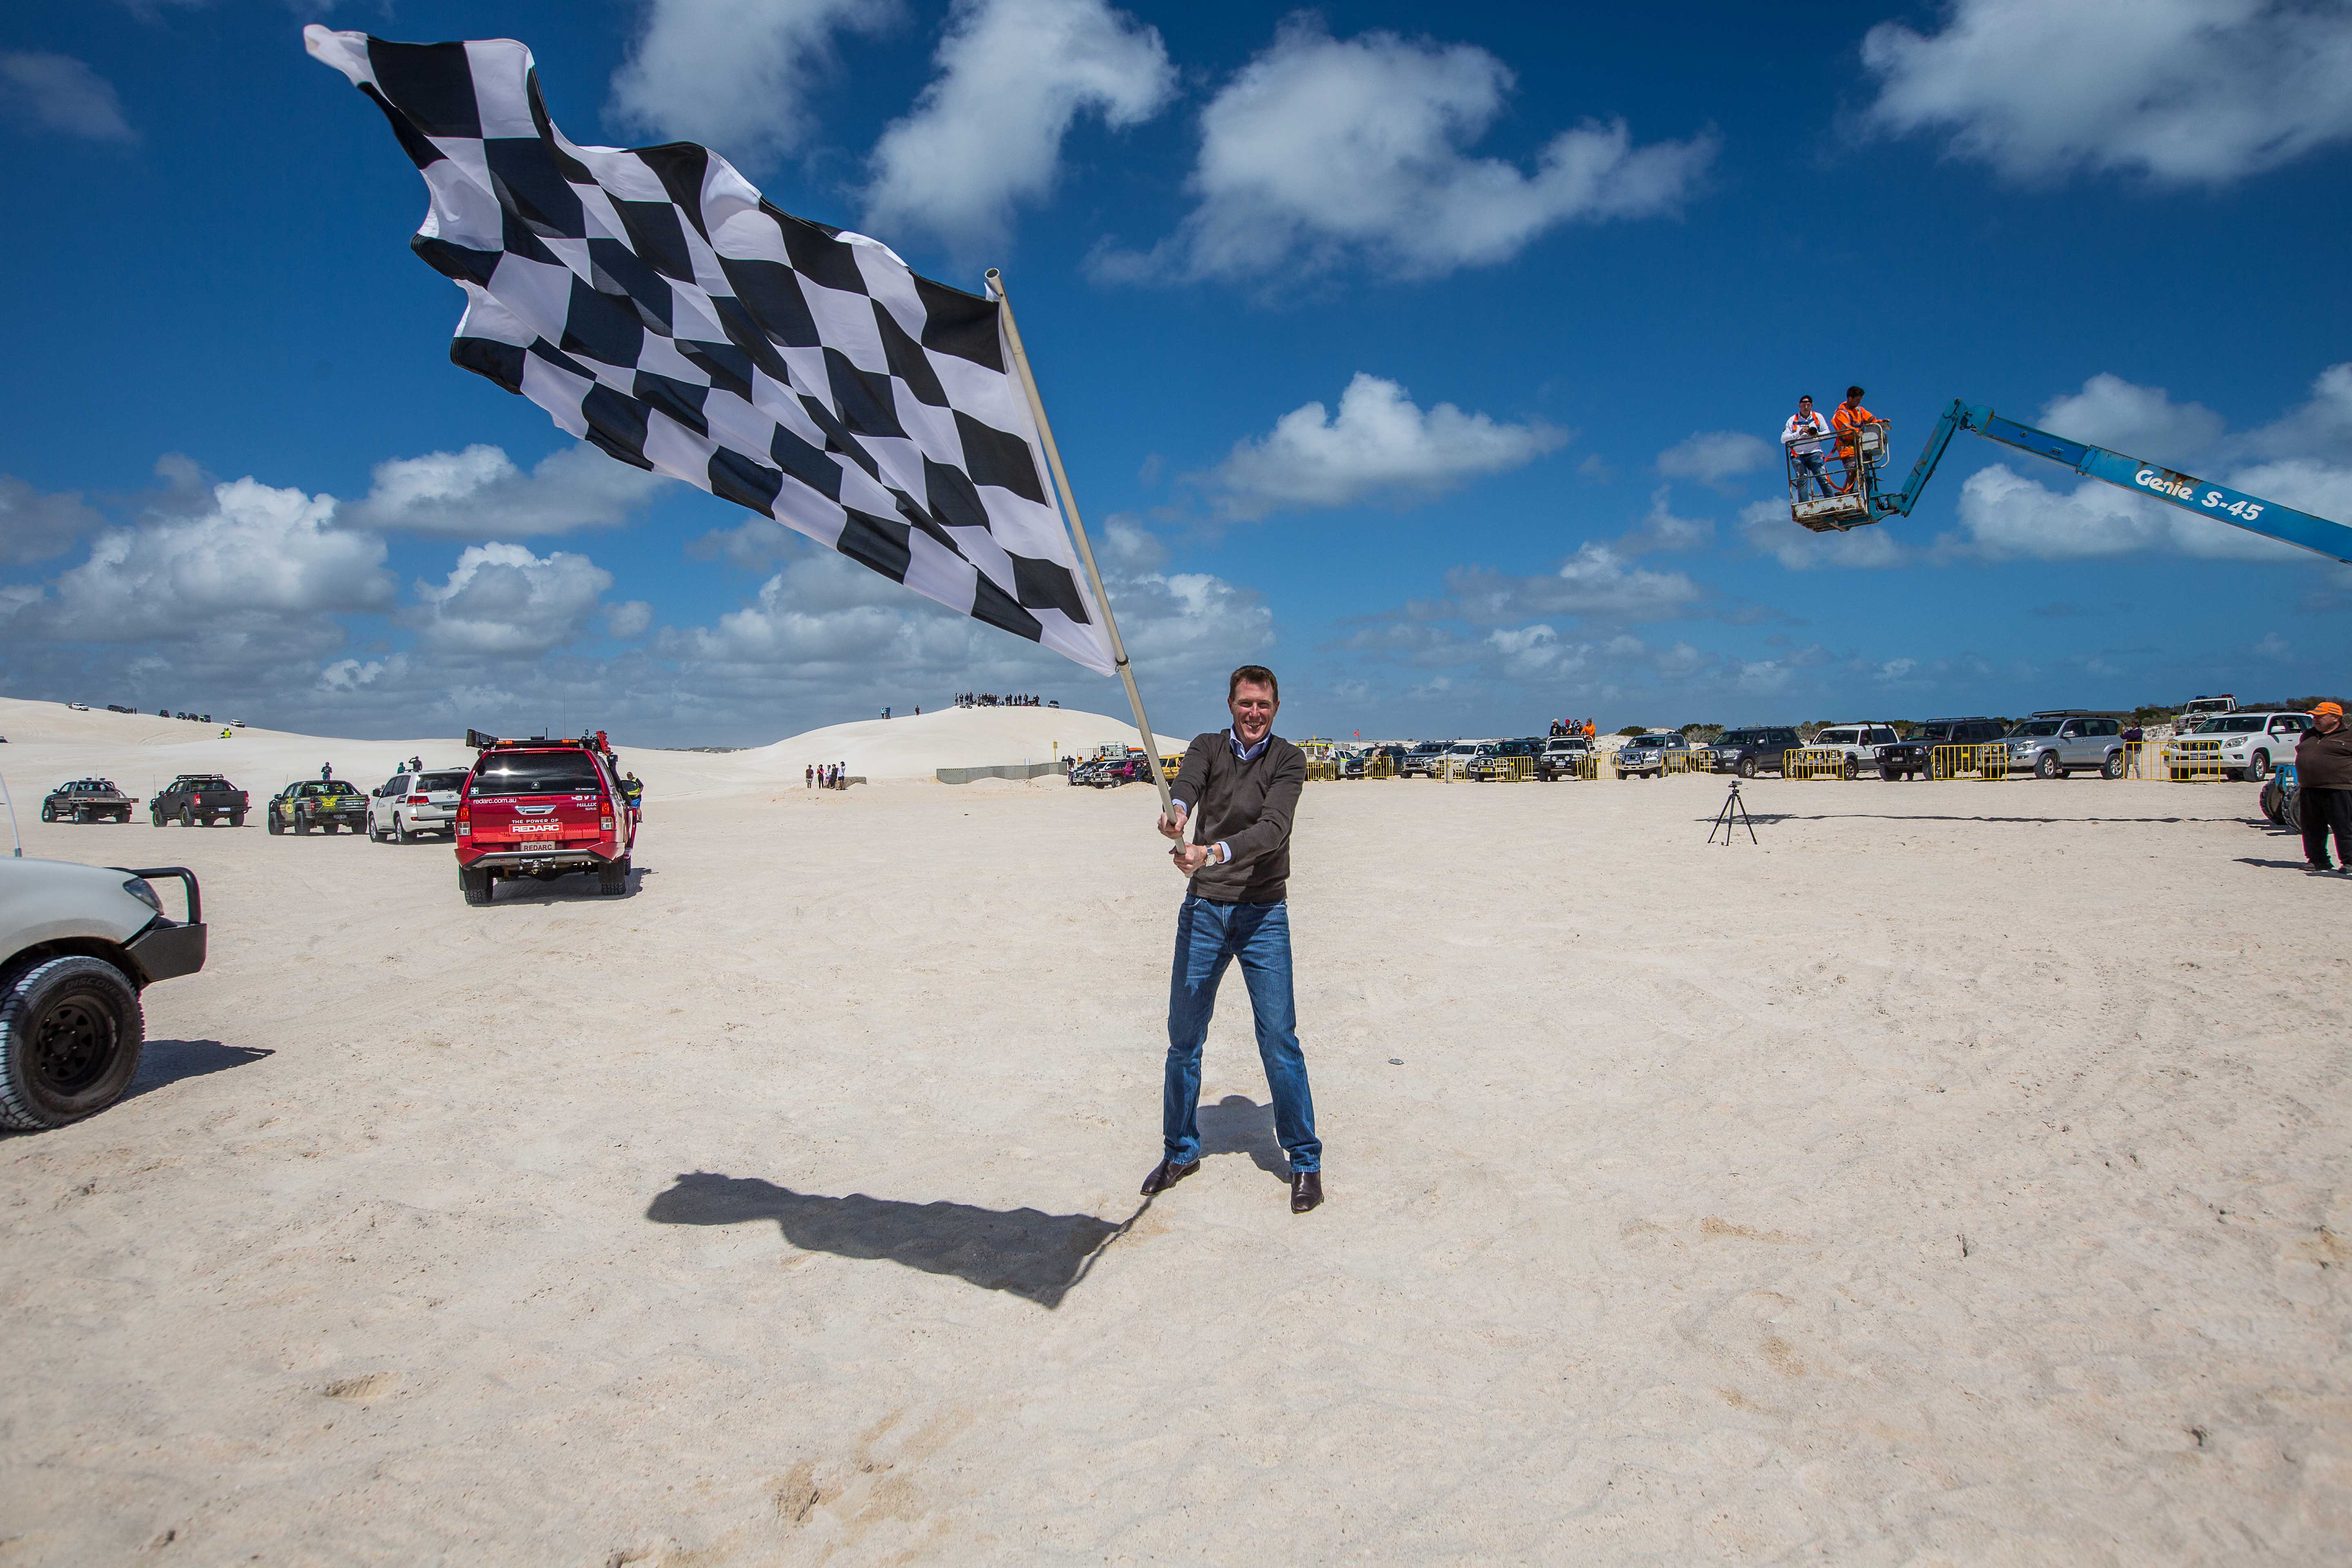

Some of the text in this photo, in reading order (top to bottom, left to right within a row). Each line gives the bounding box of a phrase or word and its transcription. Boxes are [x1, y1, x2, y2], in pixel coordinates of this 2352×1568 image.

[2136, 470, 2264, 521] Genie S-45
[512, 824, 559, 833] REDARC
